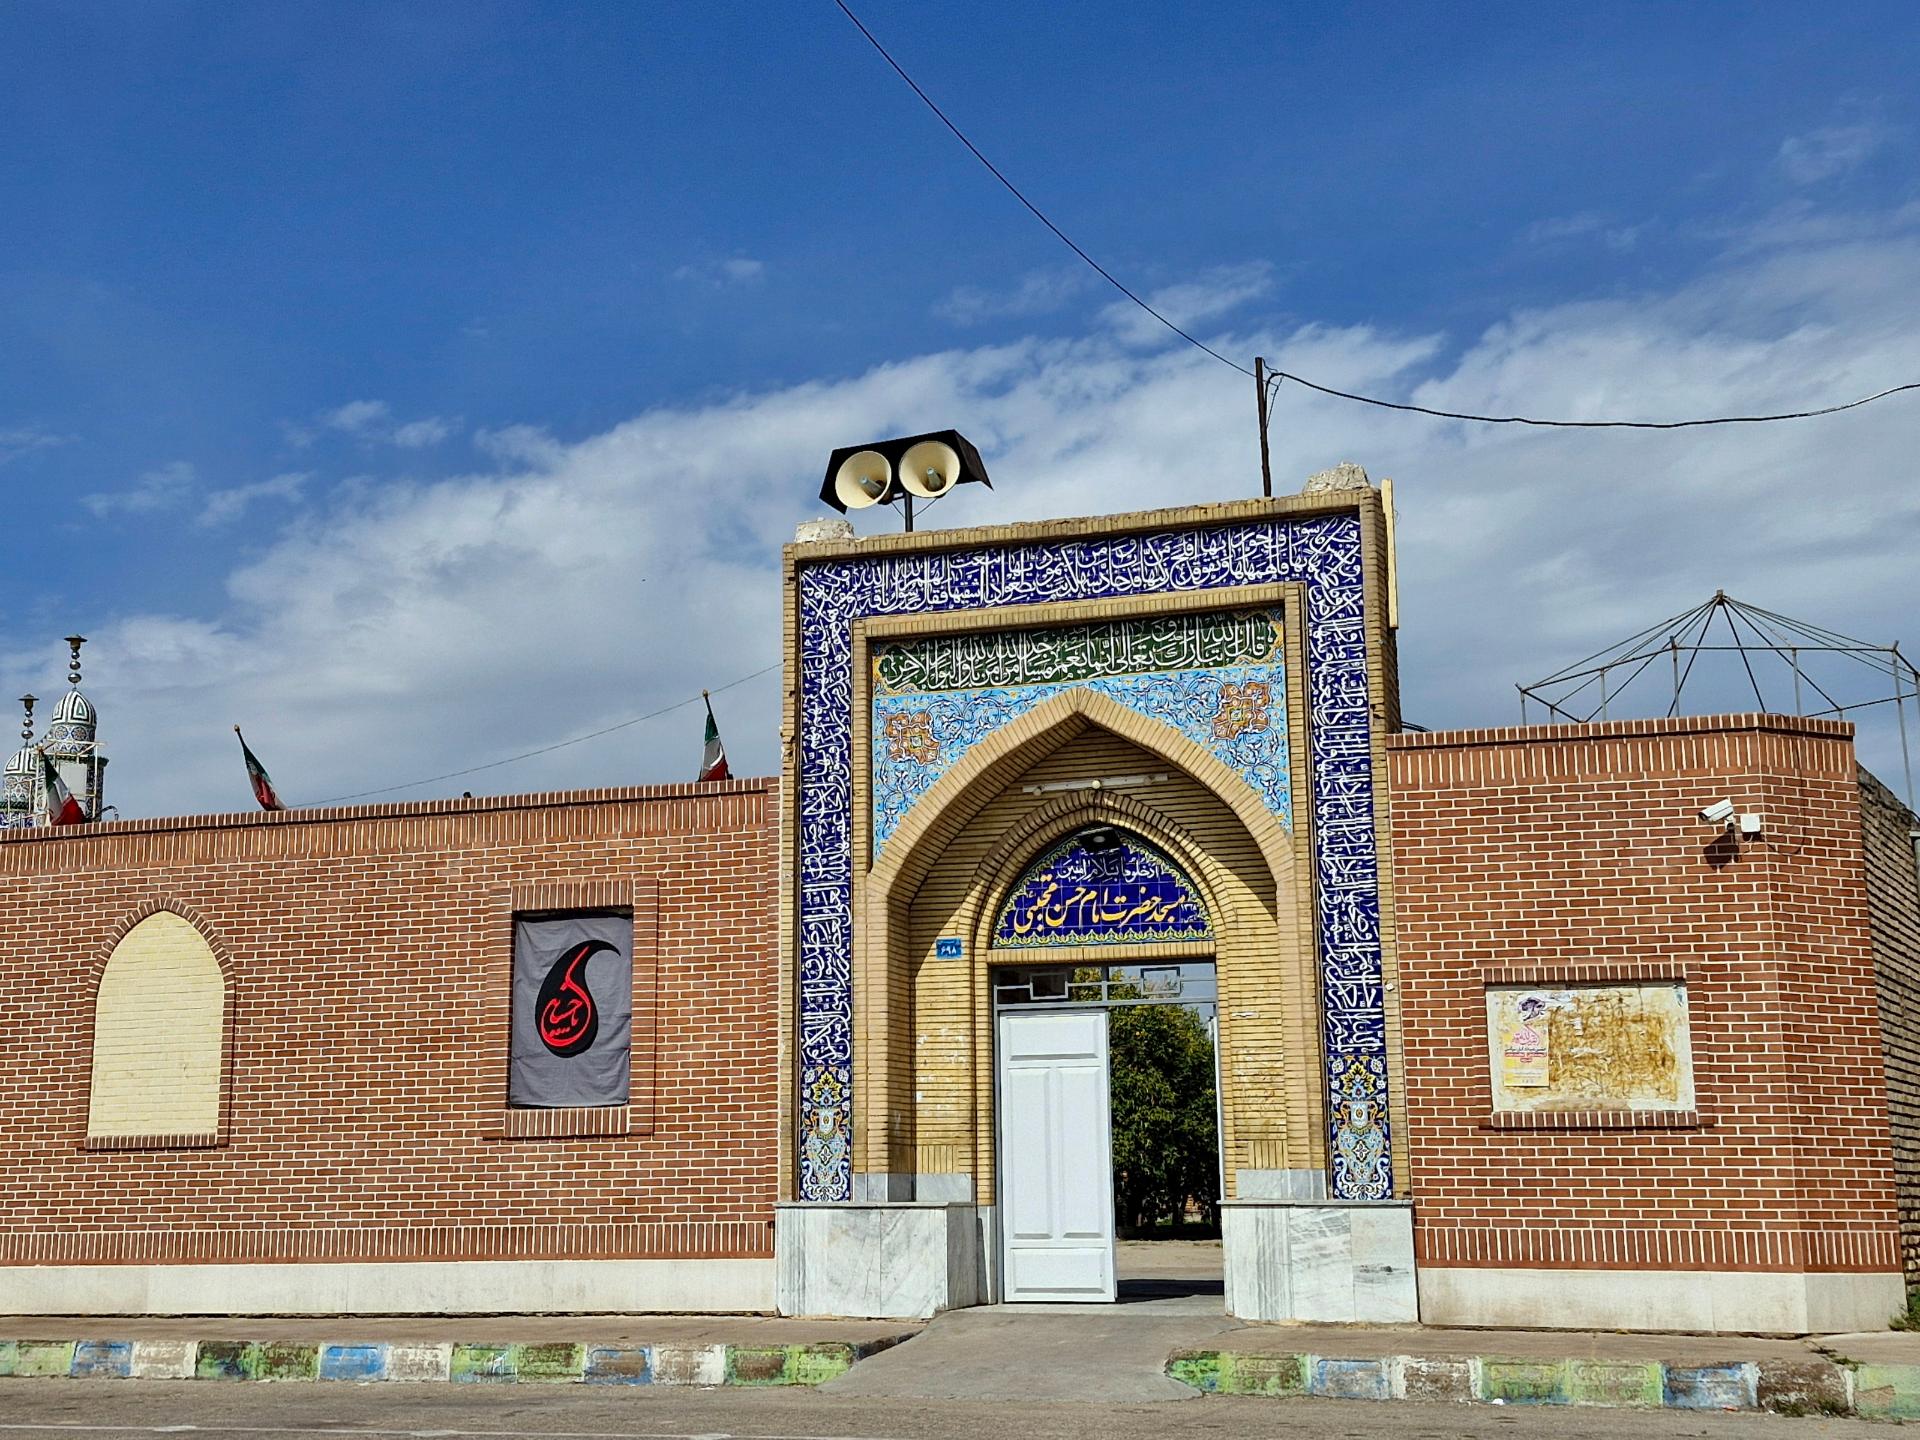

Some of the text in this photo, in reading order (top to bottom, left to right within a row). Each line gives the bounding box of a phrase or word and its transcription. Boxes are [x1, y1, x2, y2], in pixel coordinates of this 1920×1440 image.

[1046, 885, 1087, 927] حسن
[1079, 887, 1108, 928] امام
[1100, 886, 1162, 928] حضرت
[1148, 895, 1185, 924] مسجد
